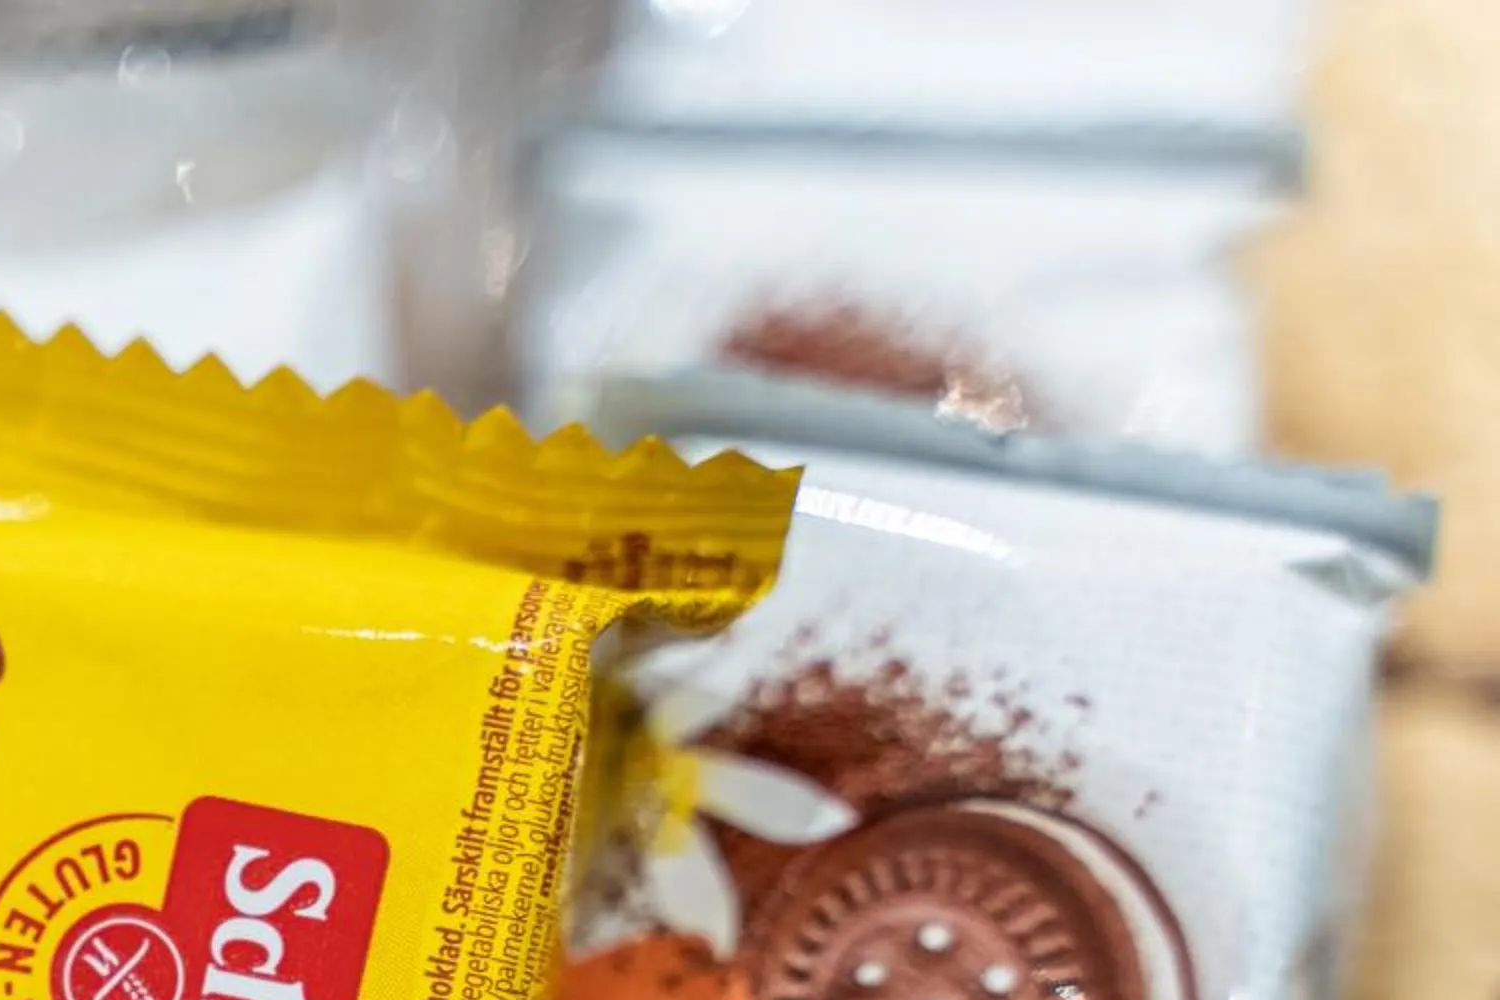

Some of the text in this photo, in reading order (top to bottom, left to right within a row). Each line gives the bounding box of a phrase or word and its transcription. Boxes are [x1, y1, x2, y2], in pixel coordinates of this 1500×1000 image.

[487, 663, 523, 701] för
[458, 701, 516, 824] framställt
[504, 705, 546, 768] fetter
[493, 767, 531, 813] och
[437, 822, 488, 917] Särskilt
[481, 812, 530, 868] oljor
